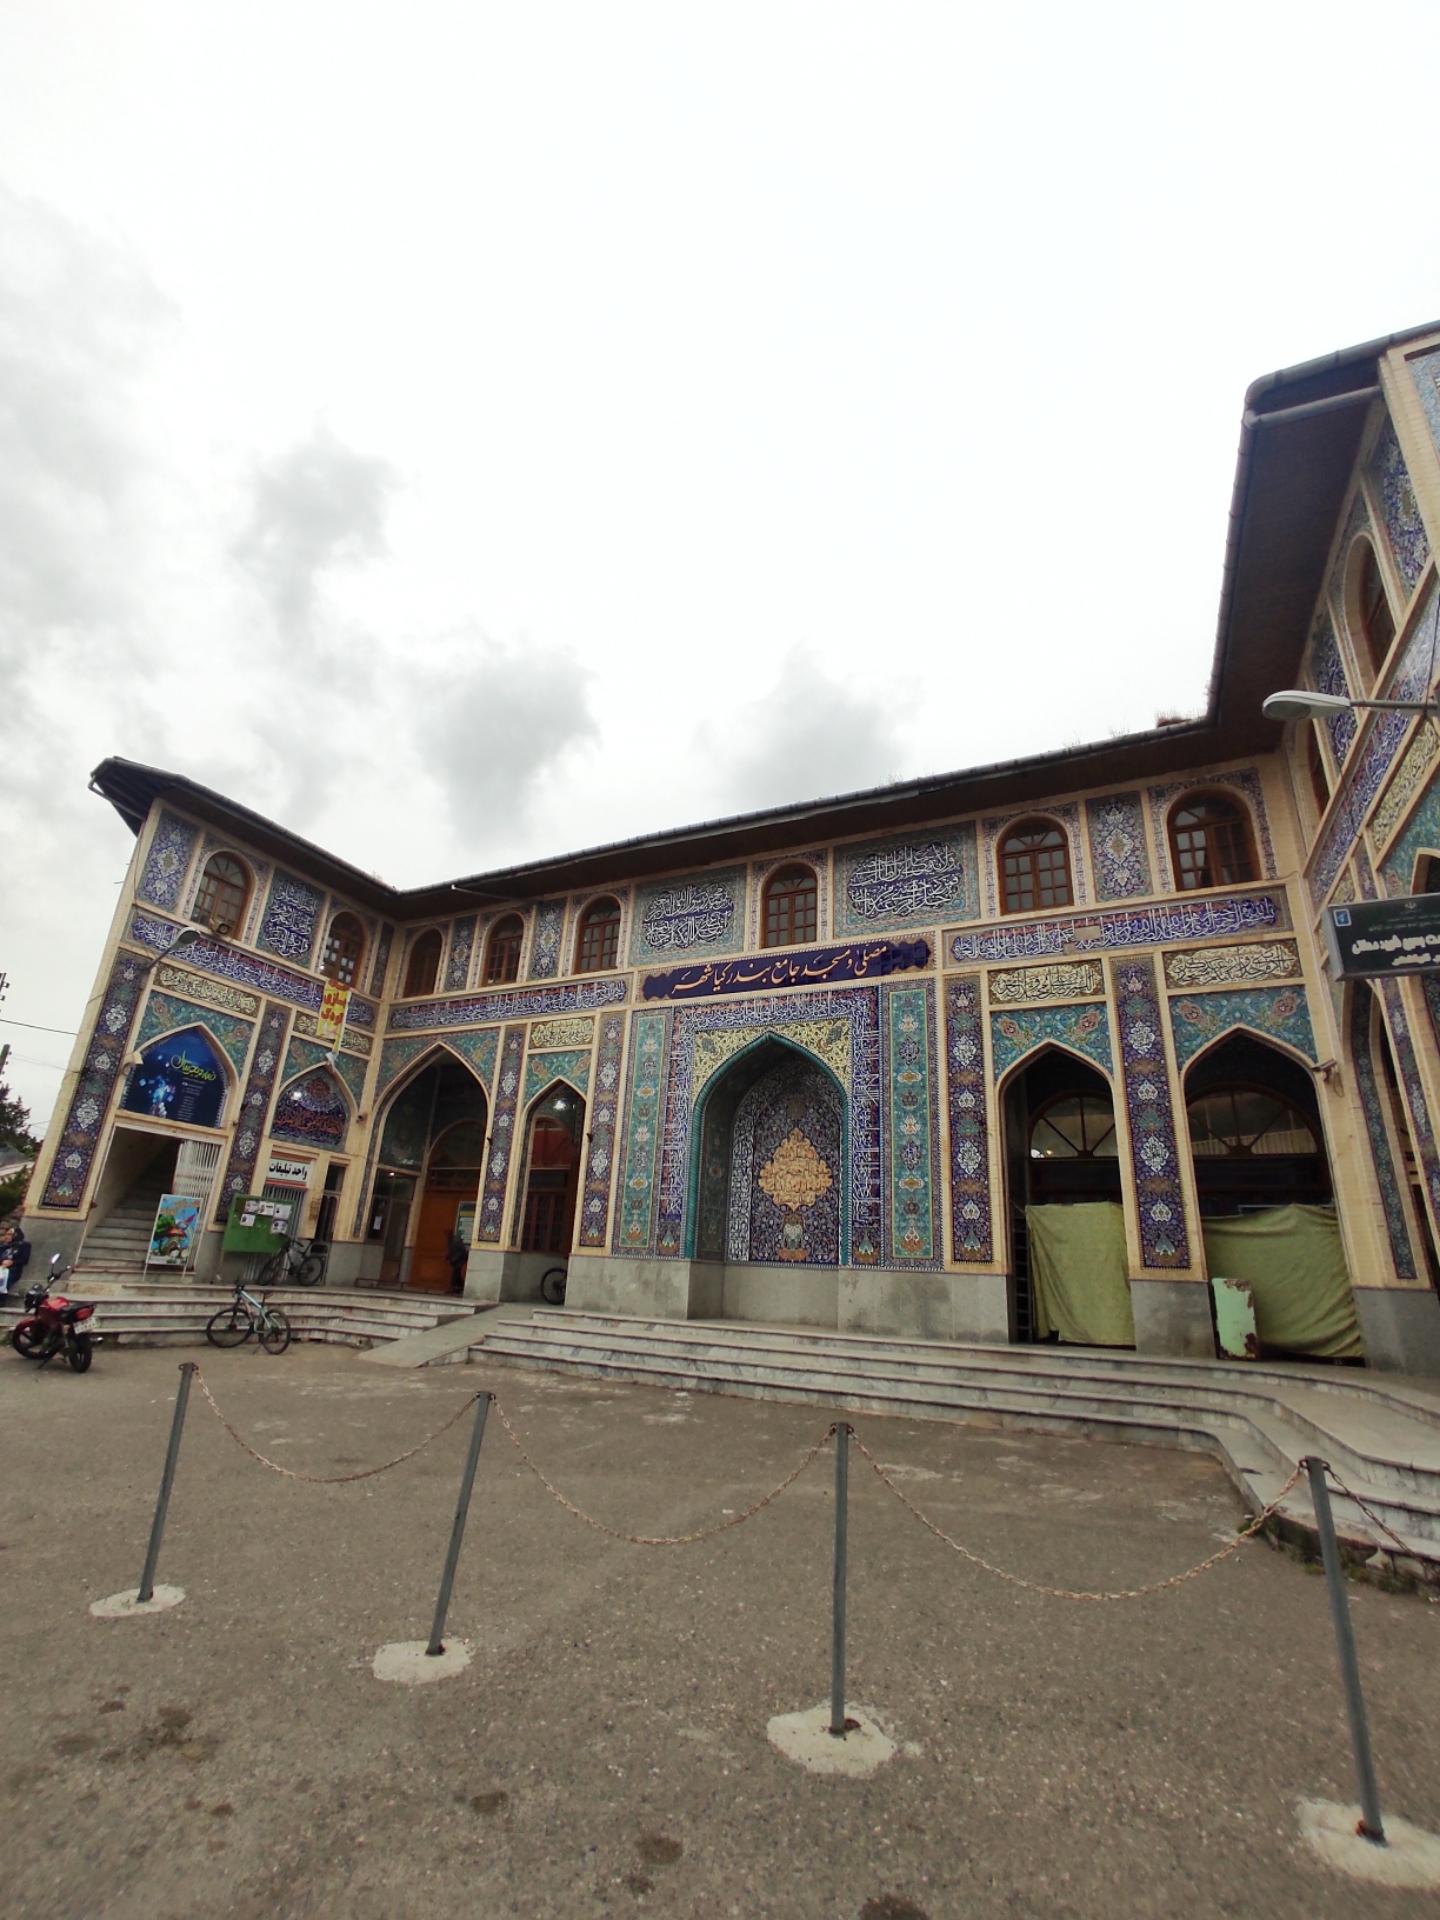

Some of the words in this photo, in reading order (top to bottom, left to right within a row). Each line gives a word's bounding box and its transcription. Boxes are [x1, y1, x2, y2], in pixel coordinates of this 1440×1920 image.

[726, 963, 771, 985] بندر
[771, 958, 800, 986] جامع
[801, 950, 851, 977] مسجد
[269, 1161, 292, 1177] تبلیغات
[292, 1165, 308, 1180] واحد
